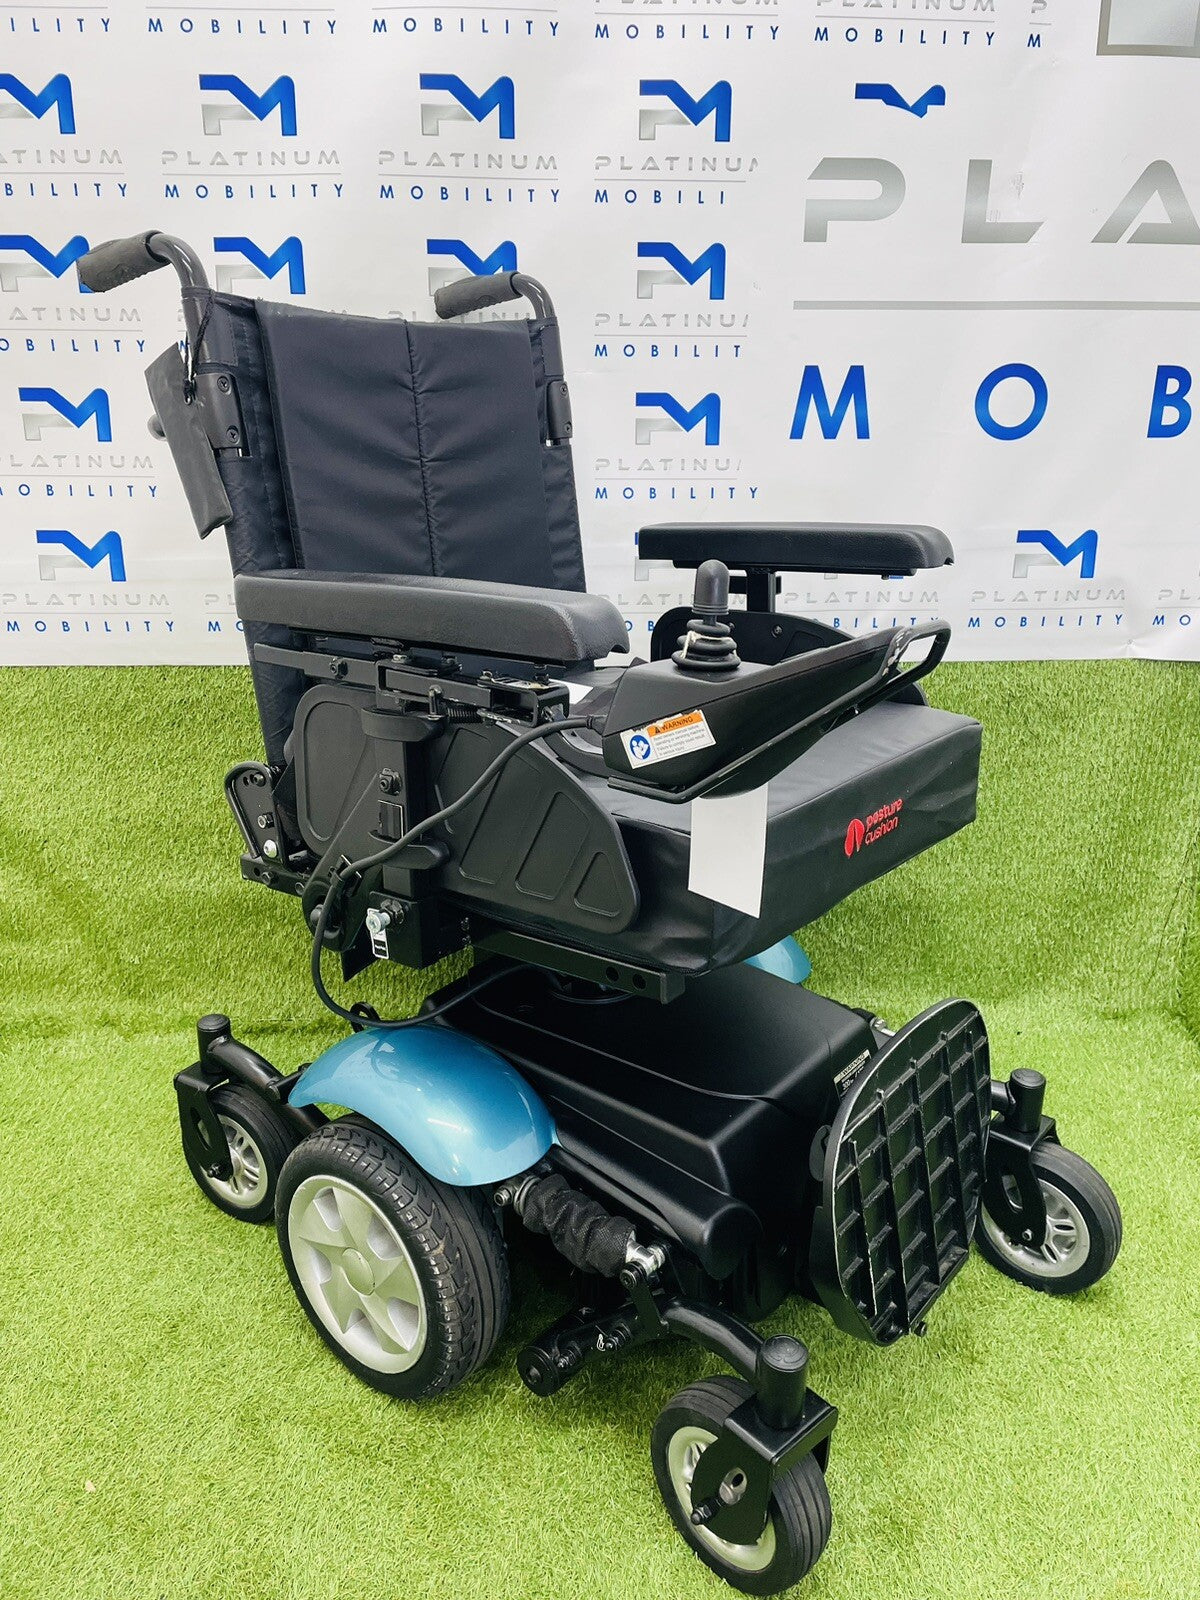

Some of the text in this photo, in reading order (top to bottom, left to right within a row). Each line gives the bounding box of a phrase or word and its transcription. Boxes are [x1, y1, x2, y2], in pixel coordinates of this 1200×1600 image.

[148, 17, 336, 34] MOBILITY
[373, 18, 559, 36] MOBILITY
[595, 24, 779, 40] MOBILITY
[814, 27, 995, 46] MOBILITY
[160, 150, 341, 166] PLATINUM
[379, 150, 558, 170] PLATINUM
[165, 184, 343, 199] MOBILITY
[380, 185, 559, 202] MOBILITY
[789, 363, 1192, 441] MOB
[0, 454, 153, 469] LATINUM
[595, 458, 741, 471] PLATINU
[0, 484, 157, 497] OBILITY
[595, 487, 758, 499] MOBILITY
[2, 593, 170, 606] PLATINUM
[784, 591, 939, 604] PLATINUM
[971, 589, 1126, 602] PLATINUM
[7, 621, 173, 632] MOBILITY
[968, 614, 1123, 628] MOBILITY
[661, 715, 694, 731] WARNING
[864, 816, 898, 846] cushion
